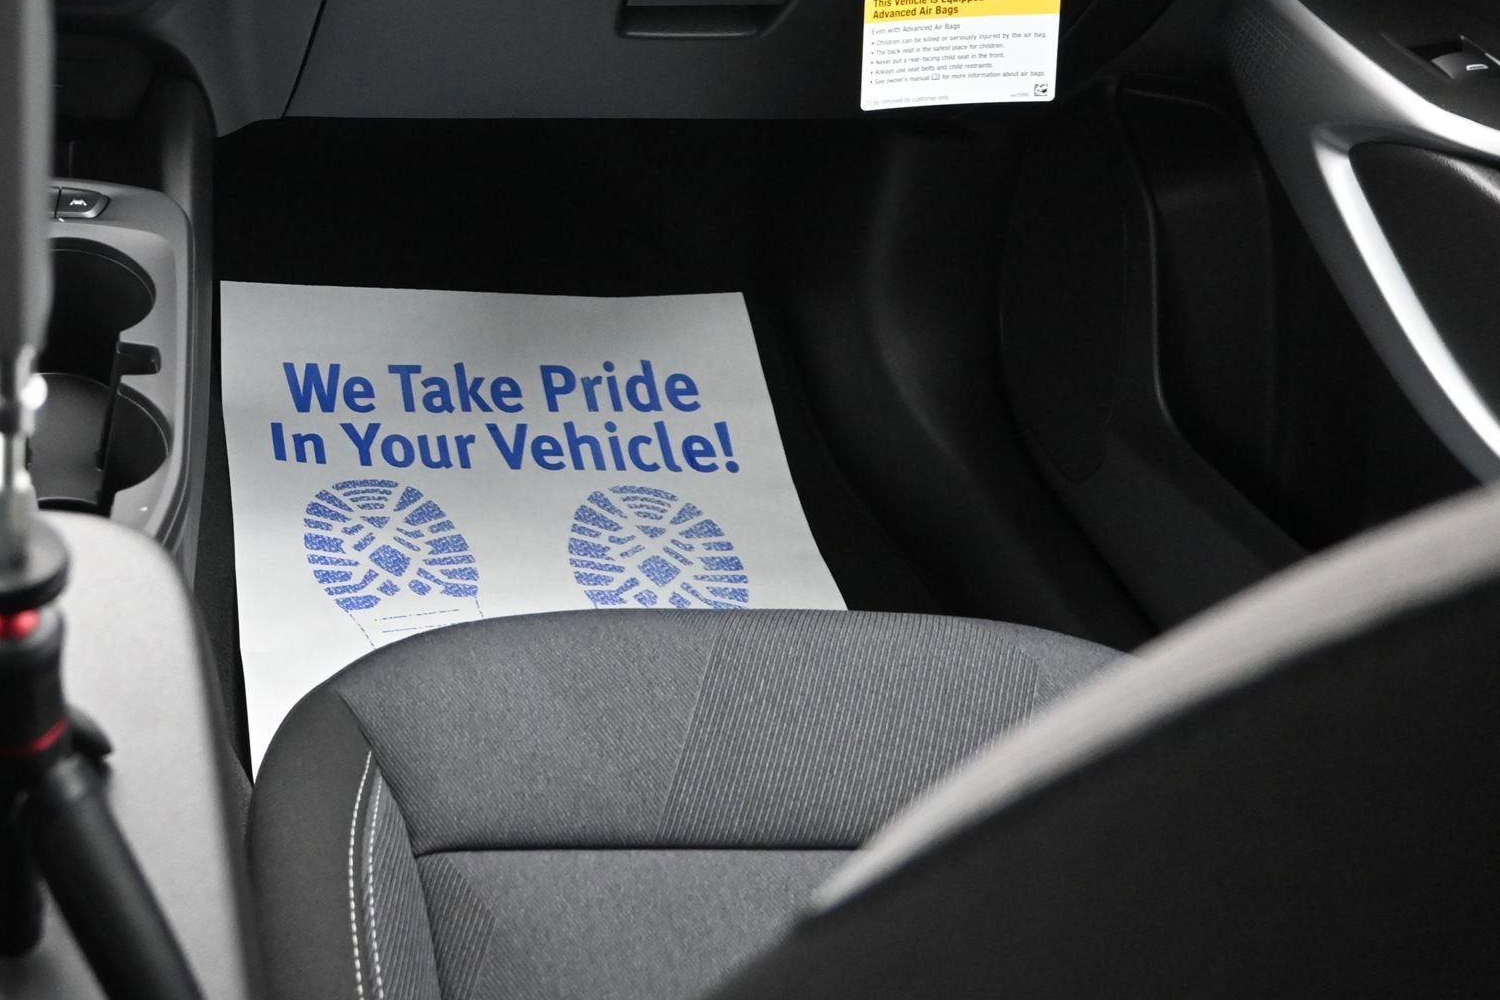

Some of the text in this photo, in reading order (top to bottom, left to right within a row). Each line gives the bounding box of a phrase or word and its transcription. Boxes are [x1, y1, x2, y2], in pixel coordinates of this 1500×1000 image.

[873, 5, 959, 19] Advanced Air Bags
[282, 359, 702, 414] We Take Pride
[270, 420, 740, 473] In Your Vehicle!
